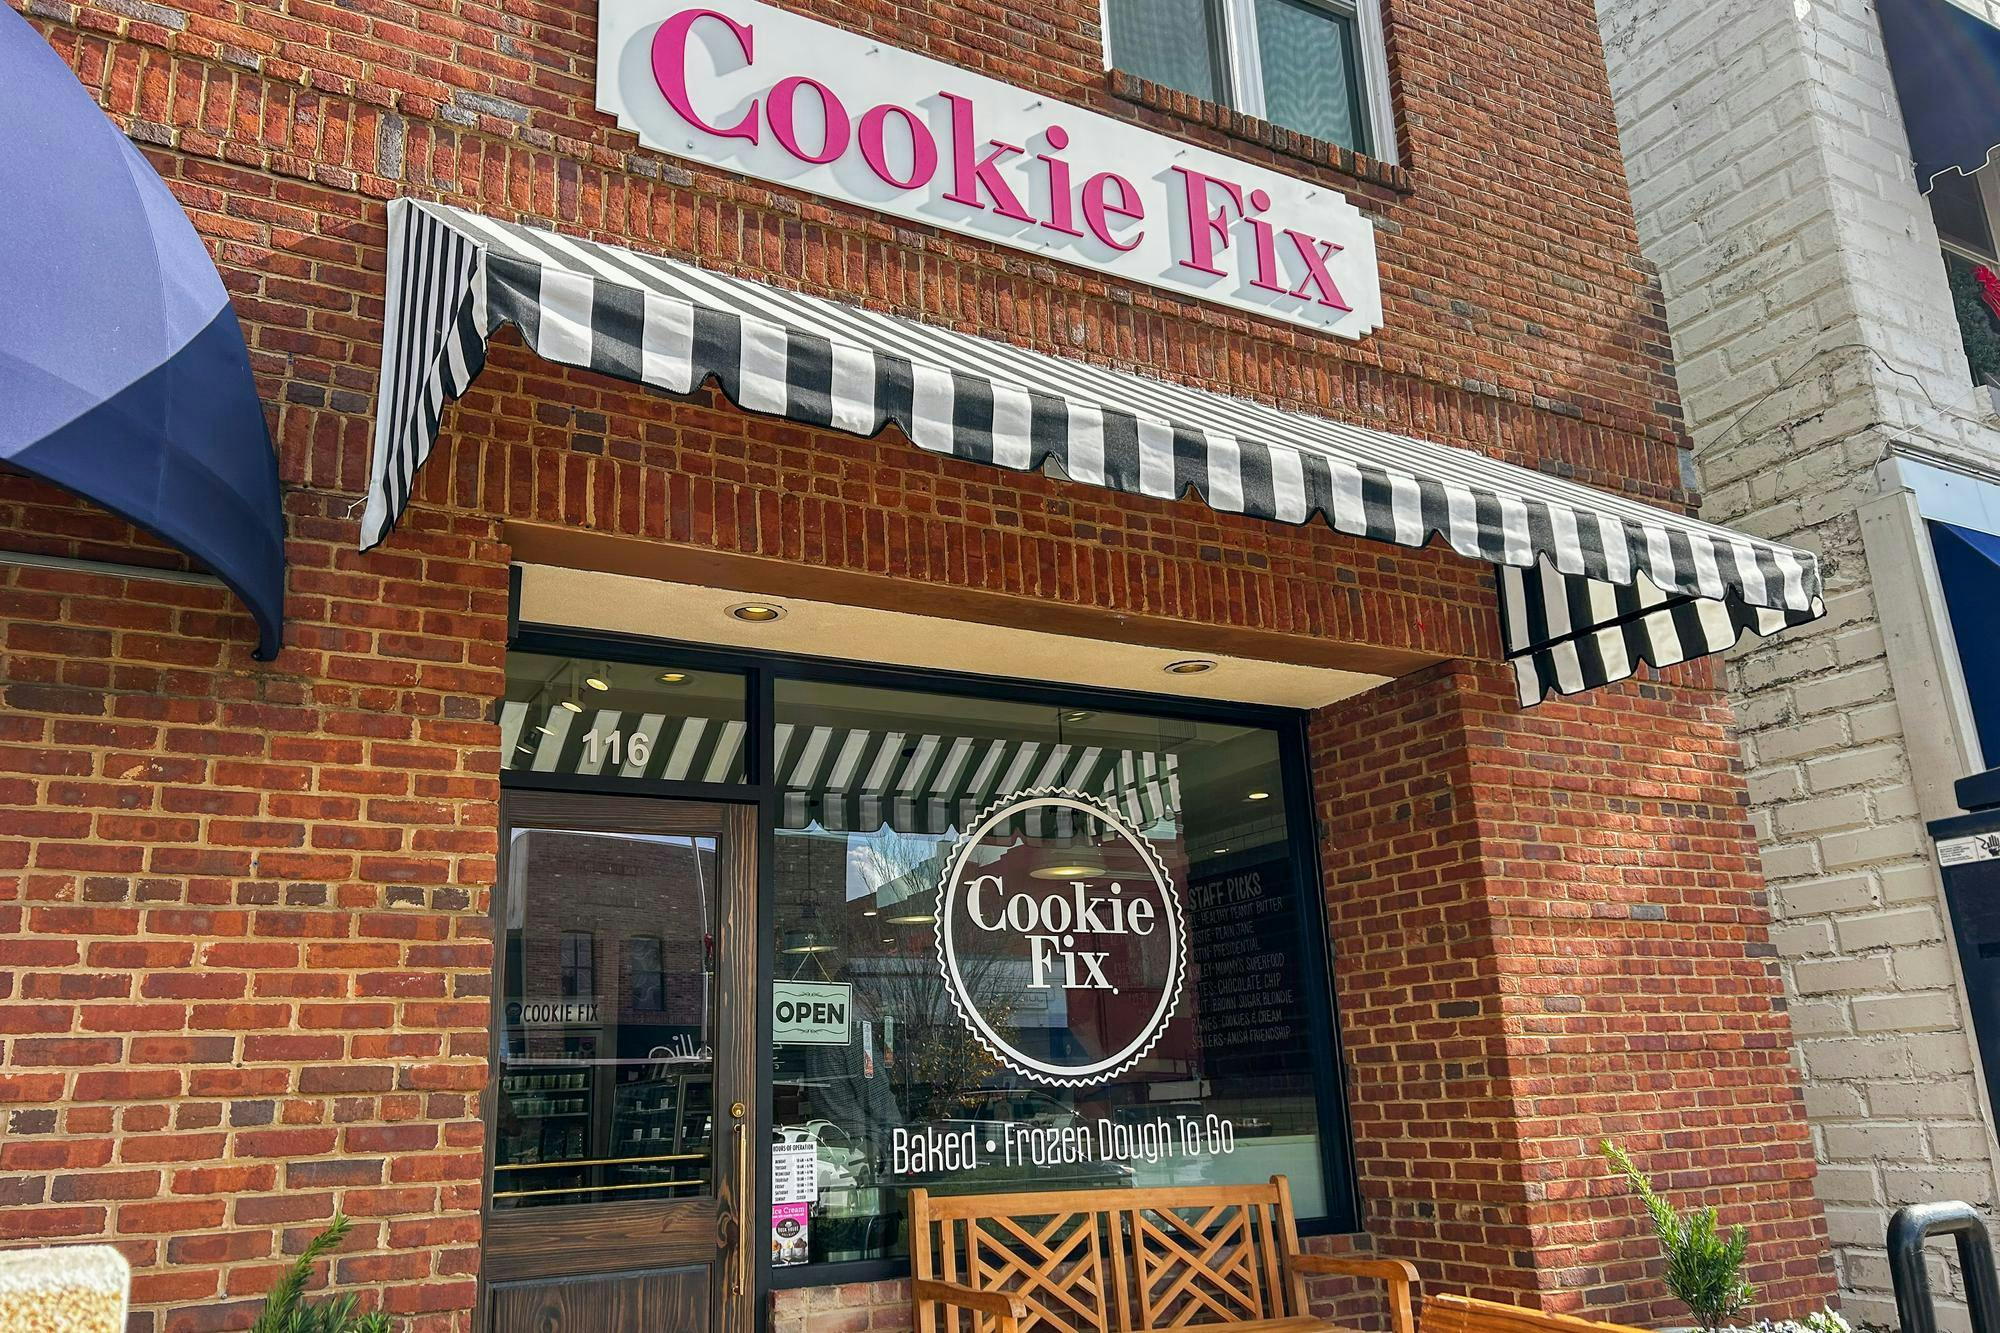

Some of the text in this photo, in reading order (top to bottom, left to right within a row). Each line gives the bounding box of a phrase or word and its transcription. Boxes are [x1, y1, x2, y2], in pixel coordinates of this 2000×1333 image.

[651, 9, 1353, 312] Cookie Fix
[582, 728, 650, 767] 116
[963, 874, 1155, 935] Cookie
[1188, 872, 1262, 911] STAFF PICKS
[1024, 934, 1119, 995] Fix.
[1218, 974, 1263, 995] CHOCOLATE
[1264, 972, 1281, 989] CHIP
[523, 1004, 598, 1022] COOKIE FIX
[776, 1001, 845, 1025] OPEN
[893, 1113, 1234, 1174] Baked Frozen Dough To Go
[783, 1206, 805, 1214] Cream
